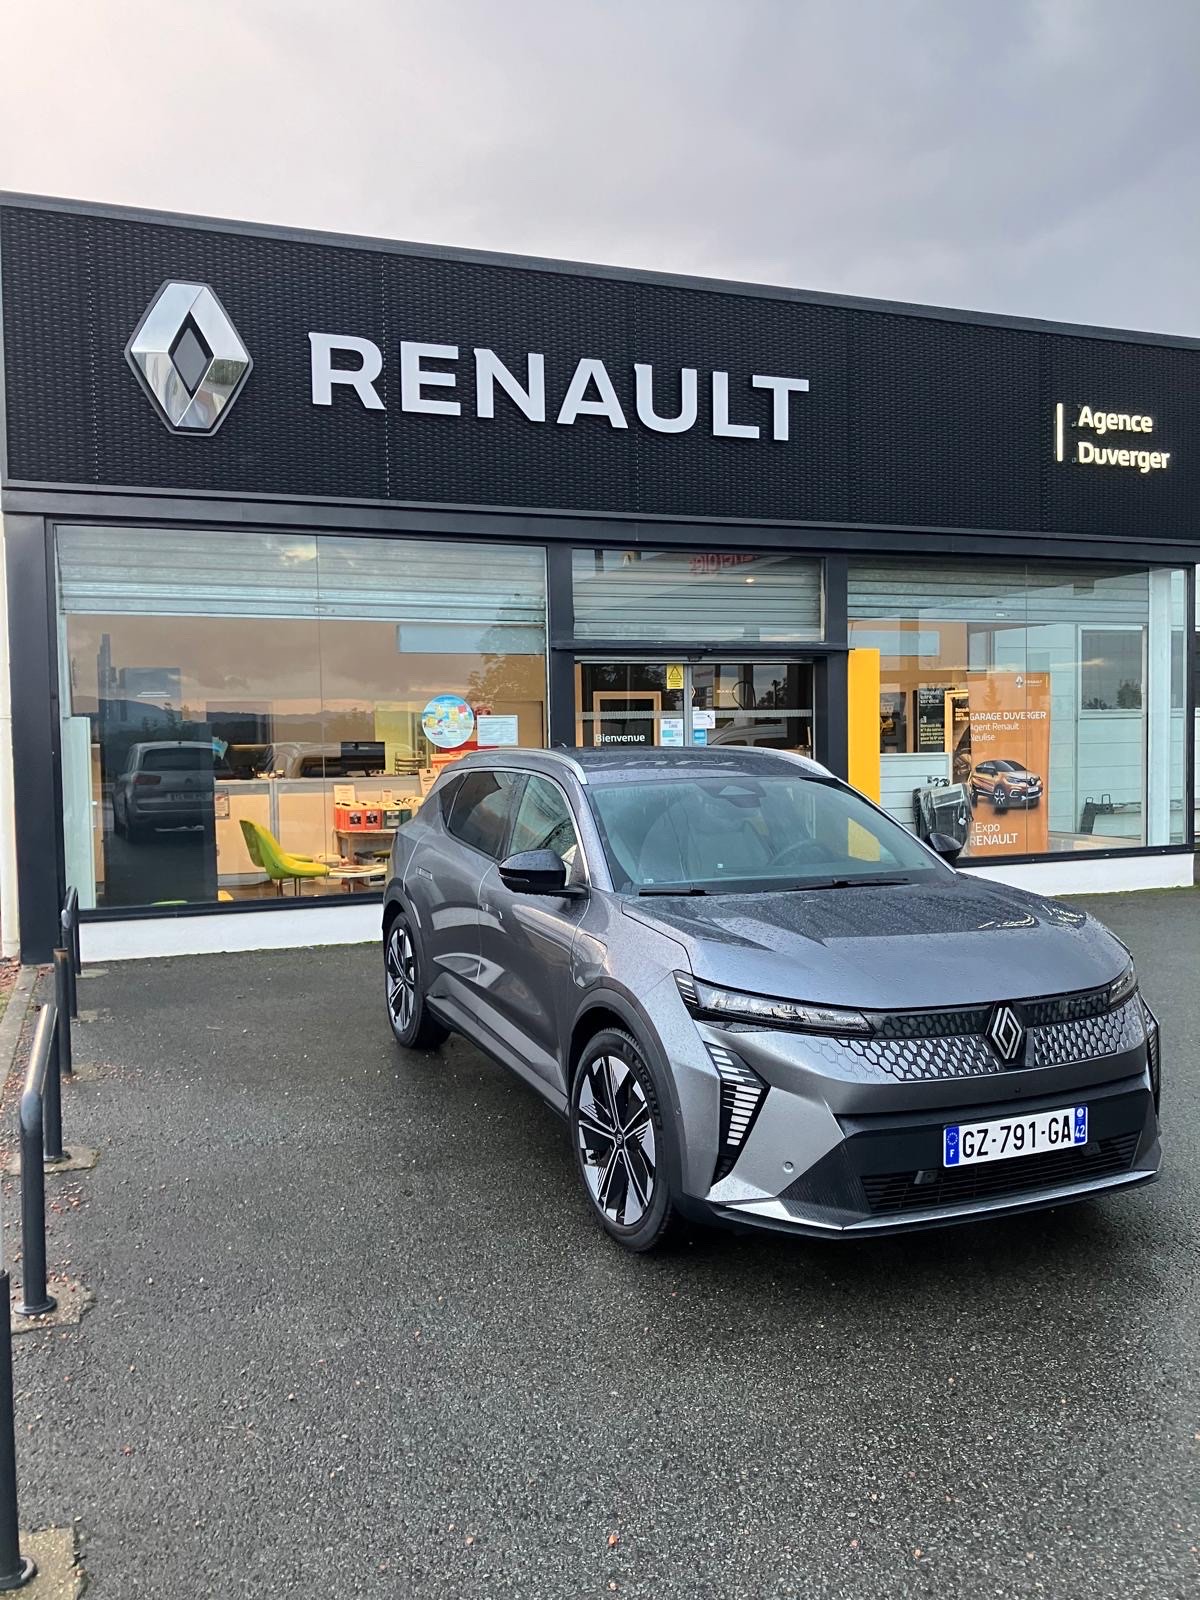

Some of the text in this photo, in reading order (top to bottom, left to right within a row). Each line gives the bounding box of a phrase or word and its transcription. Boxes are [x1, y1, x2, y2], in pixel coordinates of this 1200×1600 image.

[308, 332, 809, 441] RENAULT
[1078, 405, 1153, 435] Agence
[1077, 441, 1170, 473] Duverger
[969, 711, 1047, 721] GARAGE DUVERGER
[970, 721, 1020, 733] Agent Renault
[595, 733, 646, 743] Bienvenue
[970, 832, 1019, 847] RENAULT
[633, 1058, 663, 1131] MICHELIN
[949, 1149, 955, 1158] F
[962, 1115, 1072, 1159] GZ-791-GA
[1075, 1124, 1086, 1138] 42
